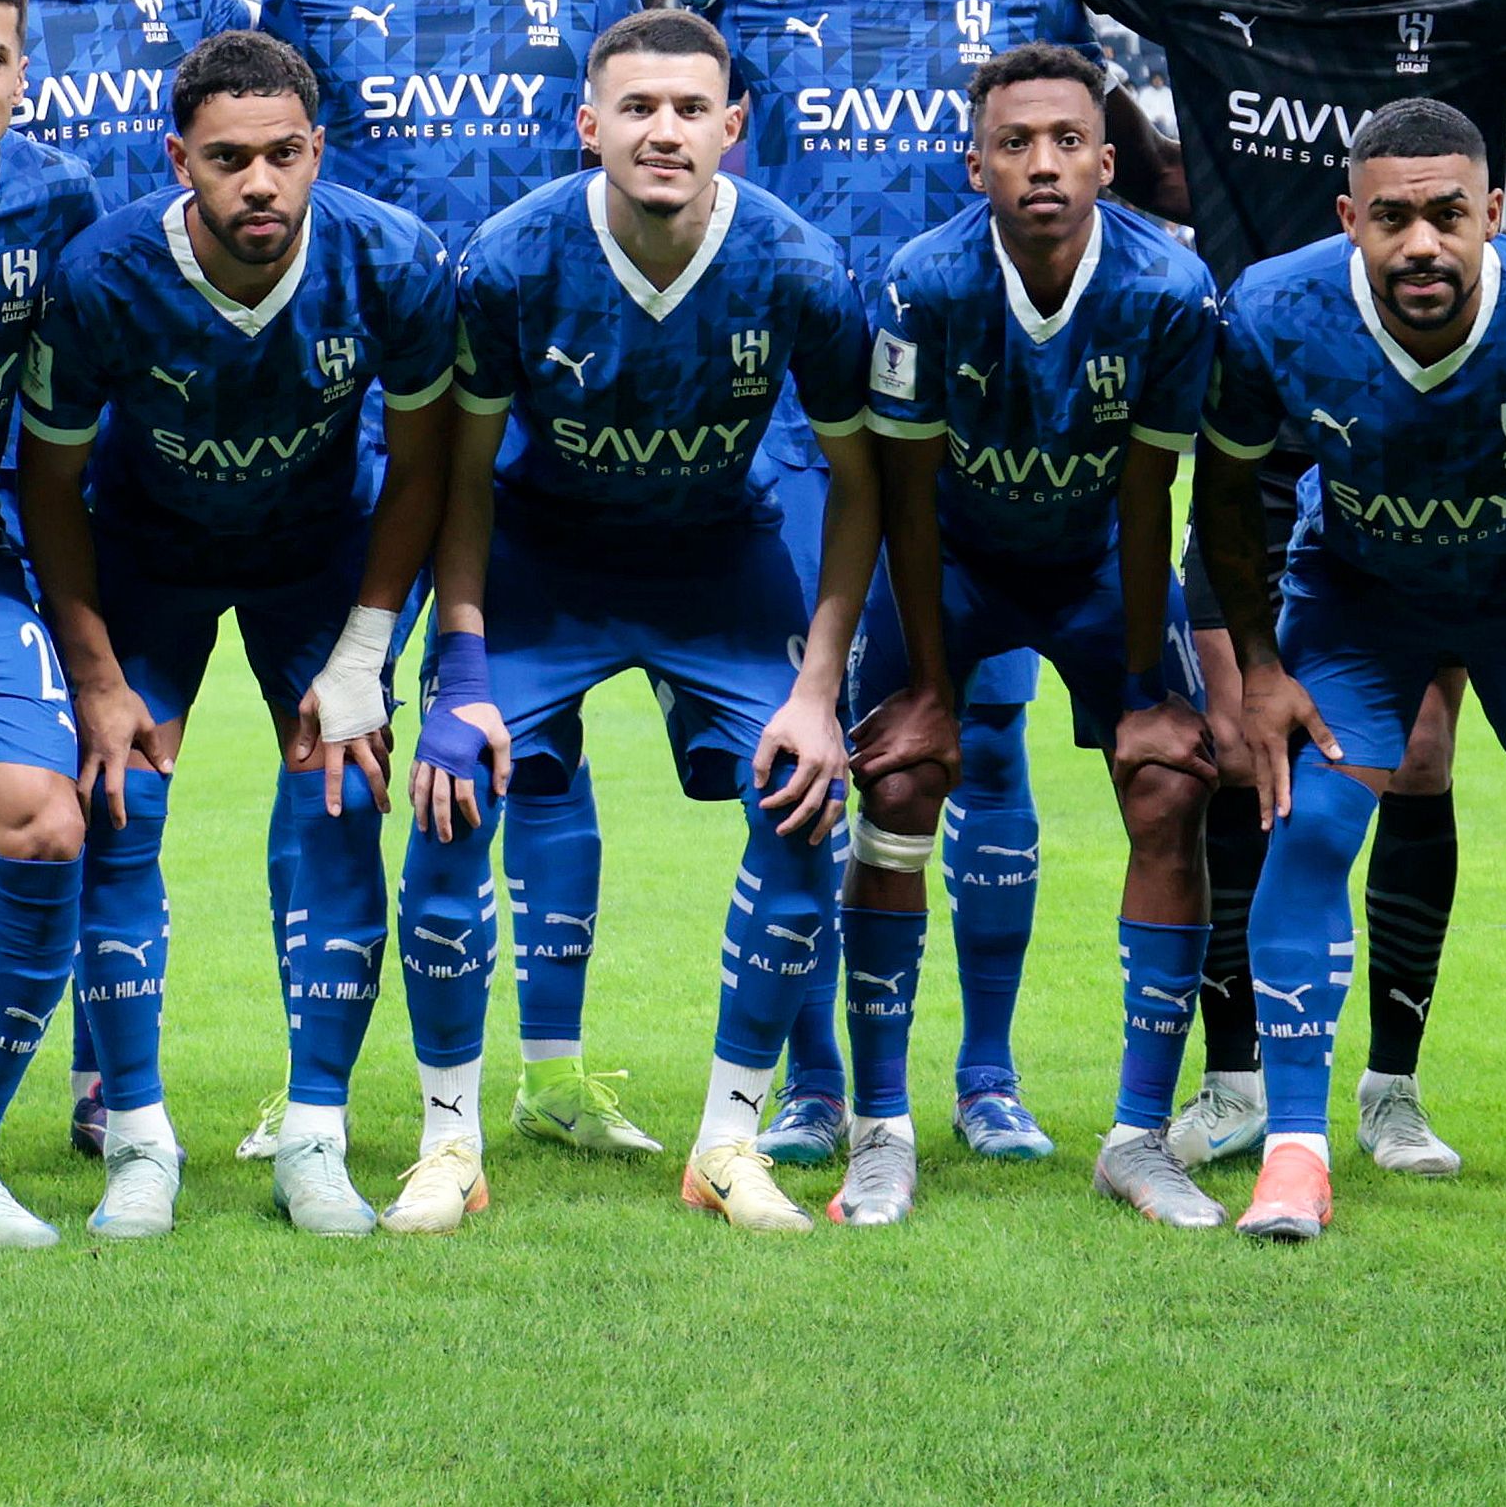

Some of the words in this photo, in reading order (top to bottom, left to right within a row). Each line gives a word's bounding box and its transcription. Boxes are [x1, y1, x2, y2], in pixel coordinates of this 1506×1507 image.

[361, 73, 545, 119] SAVVY
[797, 87, 973, 132] SAVVY
[1228, 89, 1374, 149] SAVV
[25, 125, 89, 142] AMES
[100, 118, 164, 135] GROUP
[370, 124, 453, 139] GAMES
[465, 123, 540, 137] GROUP
[803, 138, 887, 152] GAMES
[1232, 138, 1311, 164] GAMES
[152, 410, 339, 468] SAVVY
[552, 417, 750, 463] SAVVY
[561, 451, 646, 476] GAMES
[962, 872, 991, 885] AL
[998, 870, 1038, 886] HILA
[534, 945, 558, 957] AL
[562, 945, 592, 957] HILA
[403, 955, 424, 974] AL
[428, 957, 481, 979] HILAL
[748, 953, 774, 972] AL
[88, 986, 110, 1002] AL
[115, 978, 157, 999] HILAL
[308, 982, 332, 999] AL
[865, 1002, 907, 1016] HILAL
[1131, 1015, 1150, 1031] AL
[1154, 1021, 1190, 1034] HILA
[1270, 1022, 1321, 1038] HILAL
[11, 1039, 40, 1054] HILA
